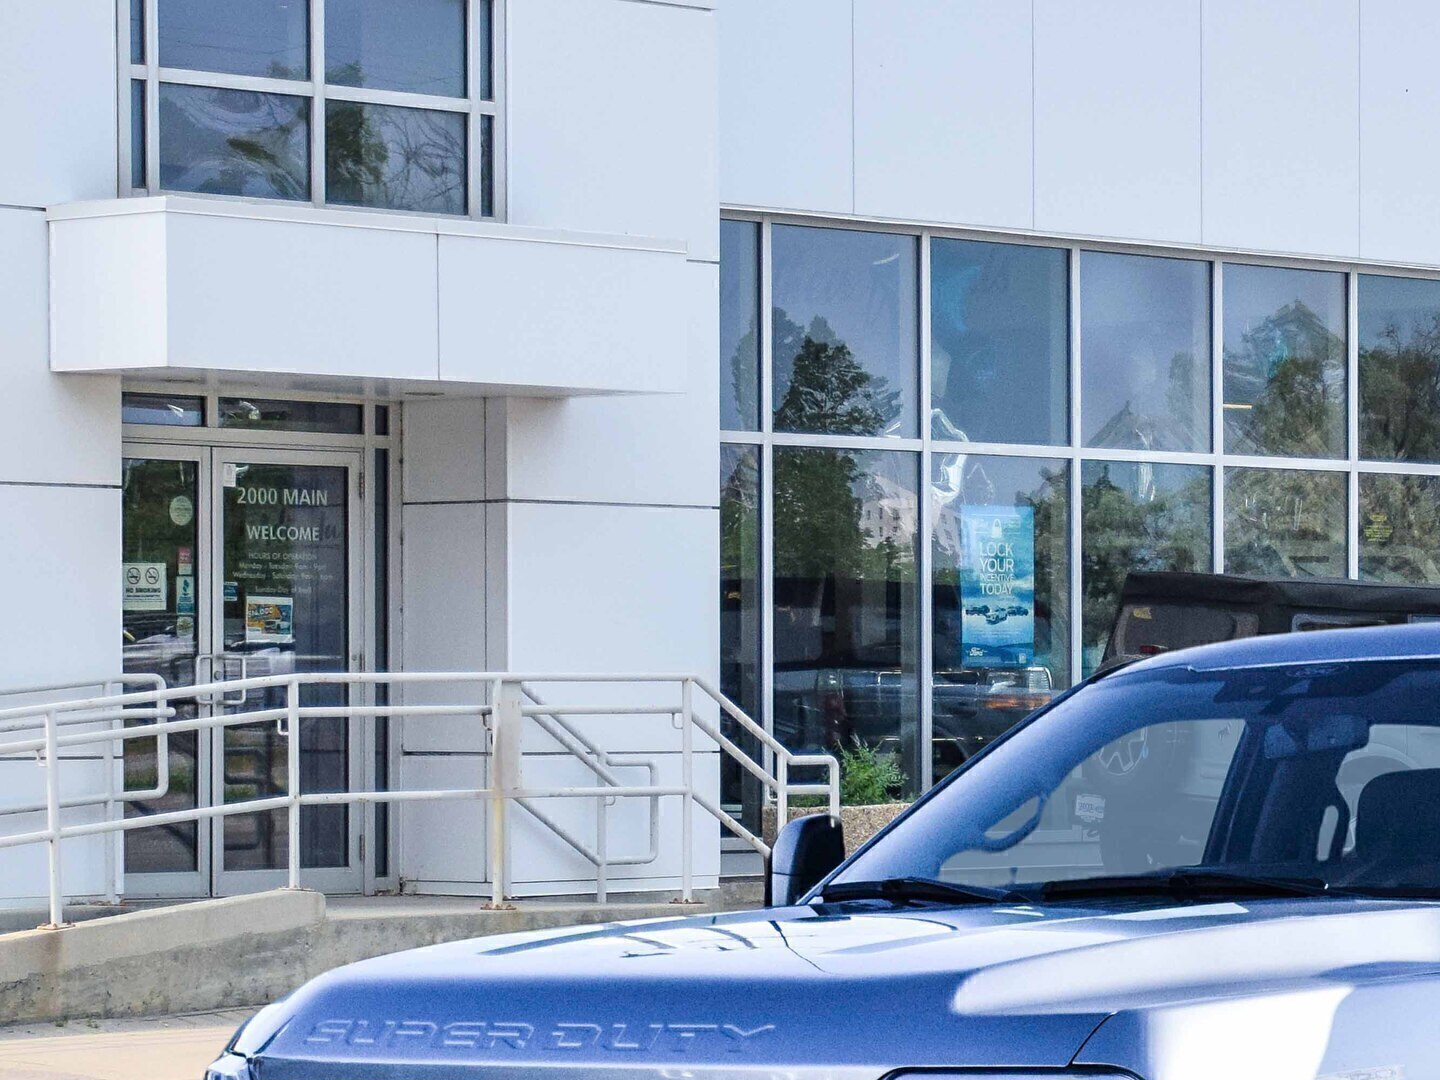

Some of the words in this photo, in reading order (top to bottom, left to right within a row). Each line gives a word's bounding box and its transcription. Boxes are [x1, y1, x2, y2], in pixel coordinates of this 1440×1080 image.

[237, 487, 277, 505] 2000
[283, 488, 328, 506] MAIN
[246, 525, 320, 541] WELCOME
[980, 542, 1014, 557] LOCK
[980, 558, 1015, 572] YOUR
[980, 583, 1013, 595] TODAY
[305, 1019, 536, 1050] SUPER
[543, 1022, 776, 1053] DUTY
